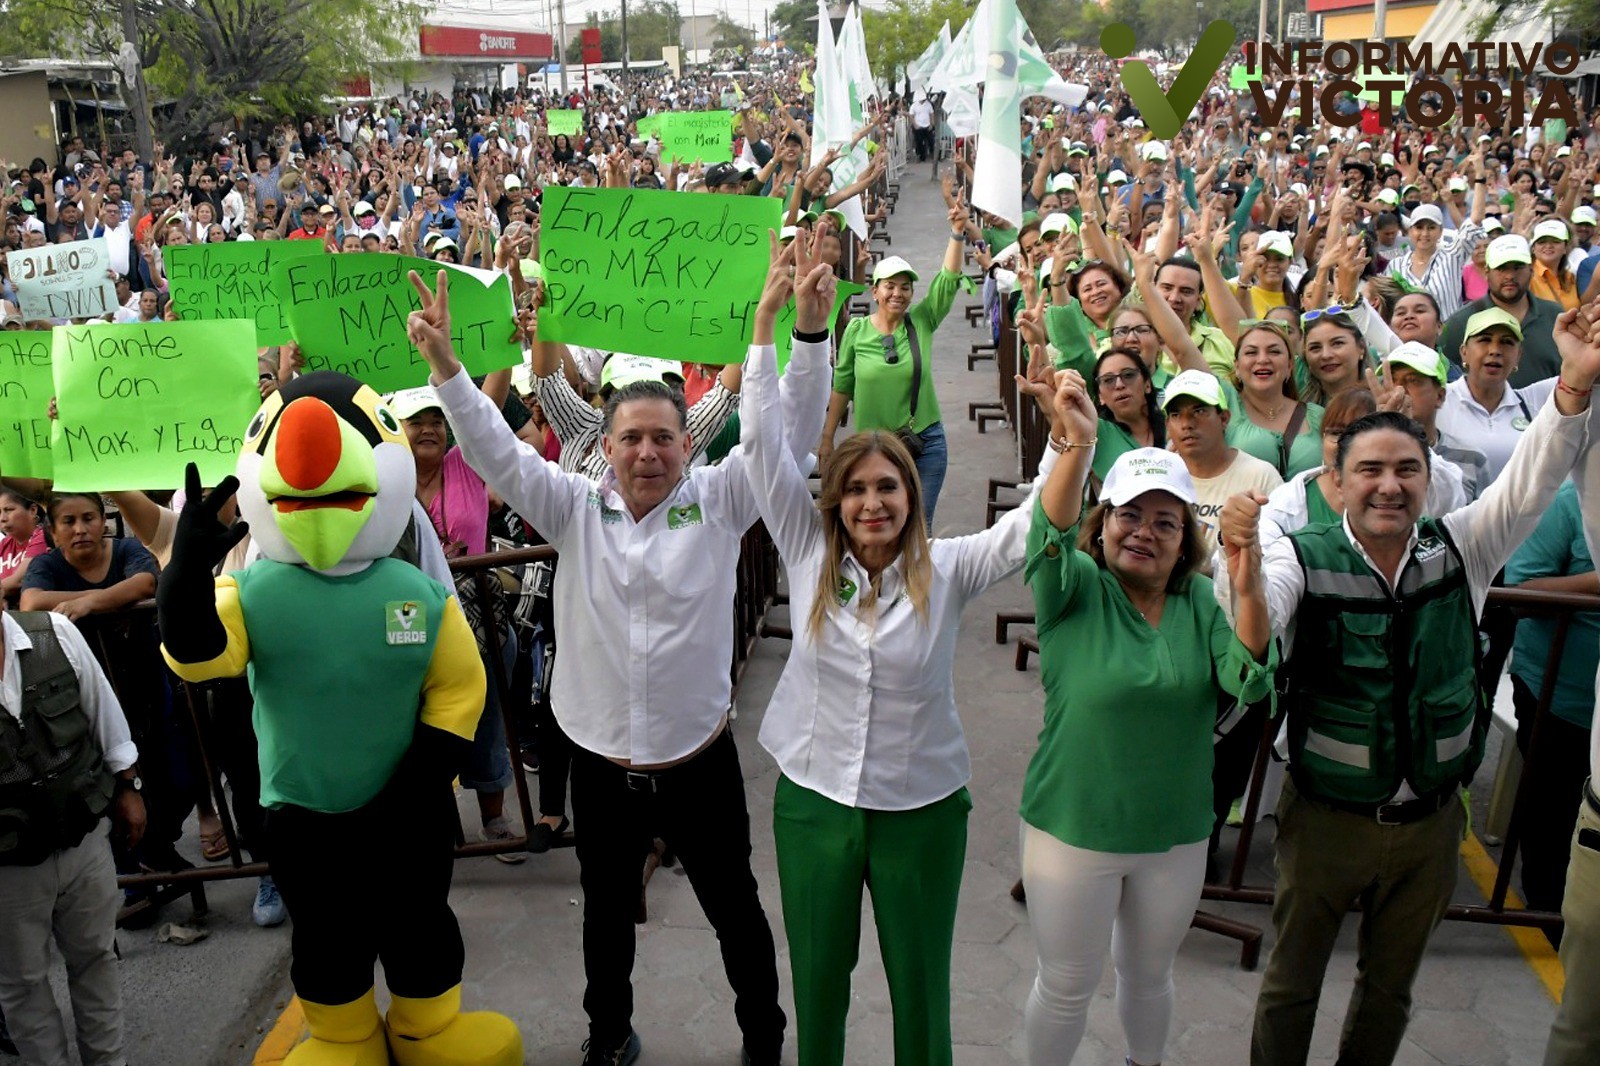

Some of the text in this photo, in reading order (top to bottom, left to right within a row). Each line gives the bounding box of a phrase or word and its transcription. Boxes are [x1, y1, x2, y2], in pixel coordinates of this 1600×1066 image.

[487, 35, 517, 50] BANORTE
[549, 190, 761, 259] Enlazados
[9, 246, 99, 281] CONTIGO
[604, 247, 723, 290] MAKY
[215, 280, 279, 305] MAK
[546, 282, 625, 331] Plan
[689, 300, 723, 337] Es
[0, 338, 53, 366] nte
[66, 328, 183, 362] Mante
[98, 365, 160, 399] Con
[174, 418, 244, 454] Eugen
[387, 631, 428, 645] VERDE
